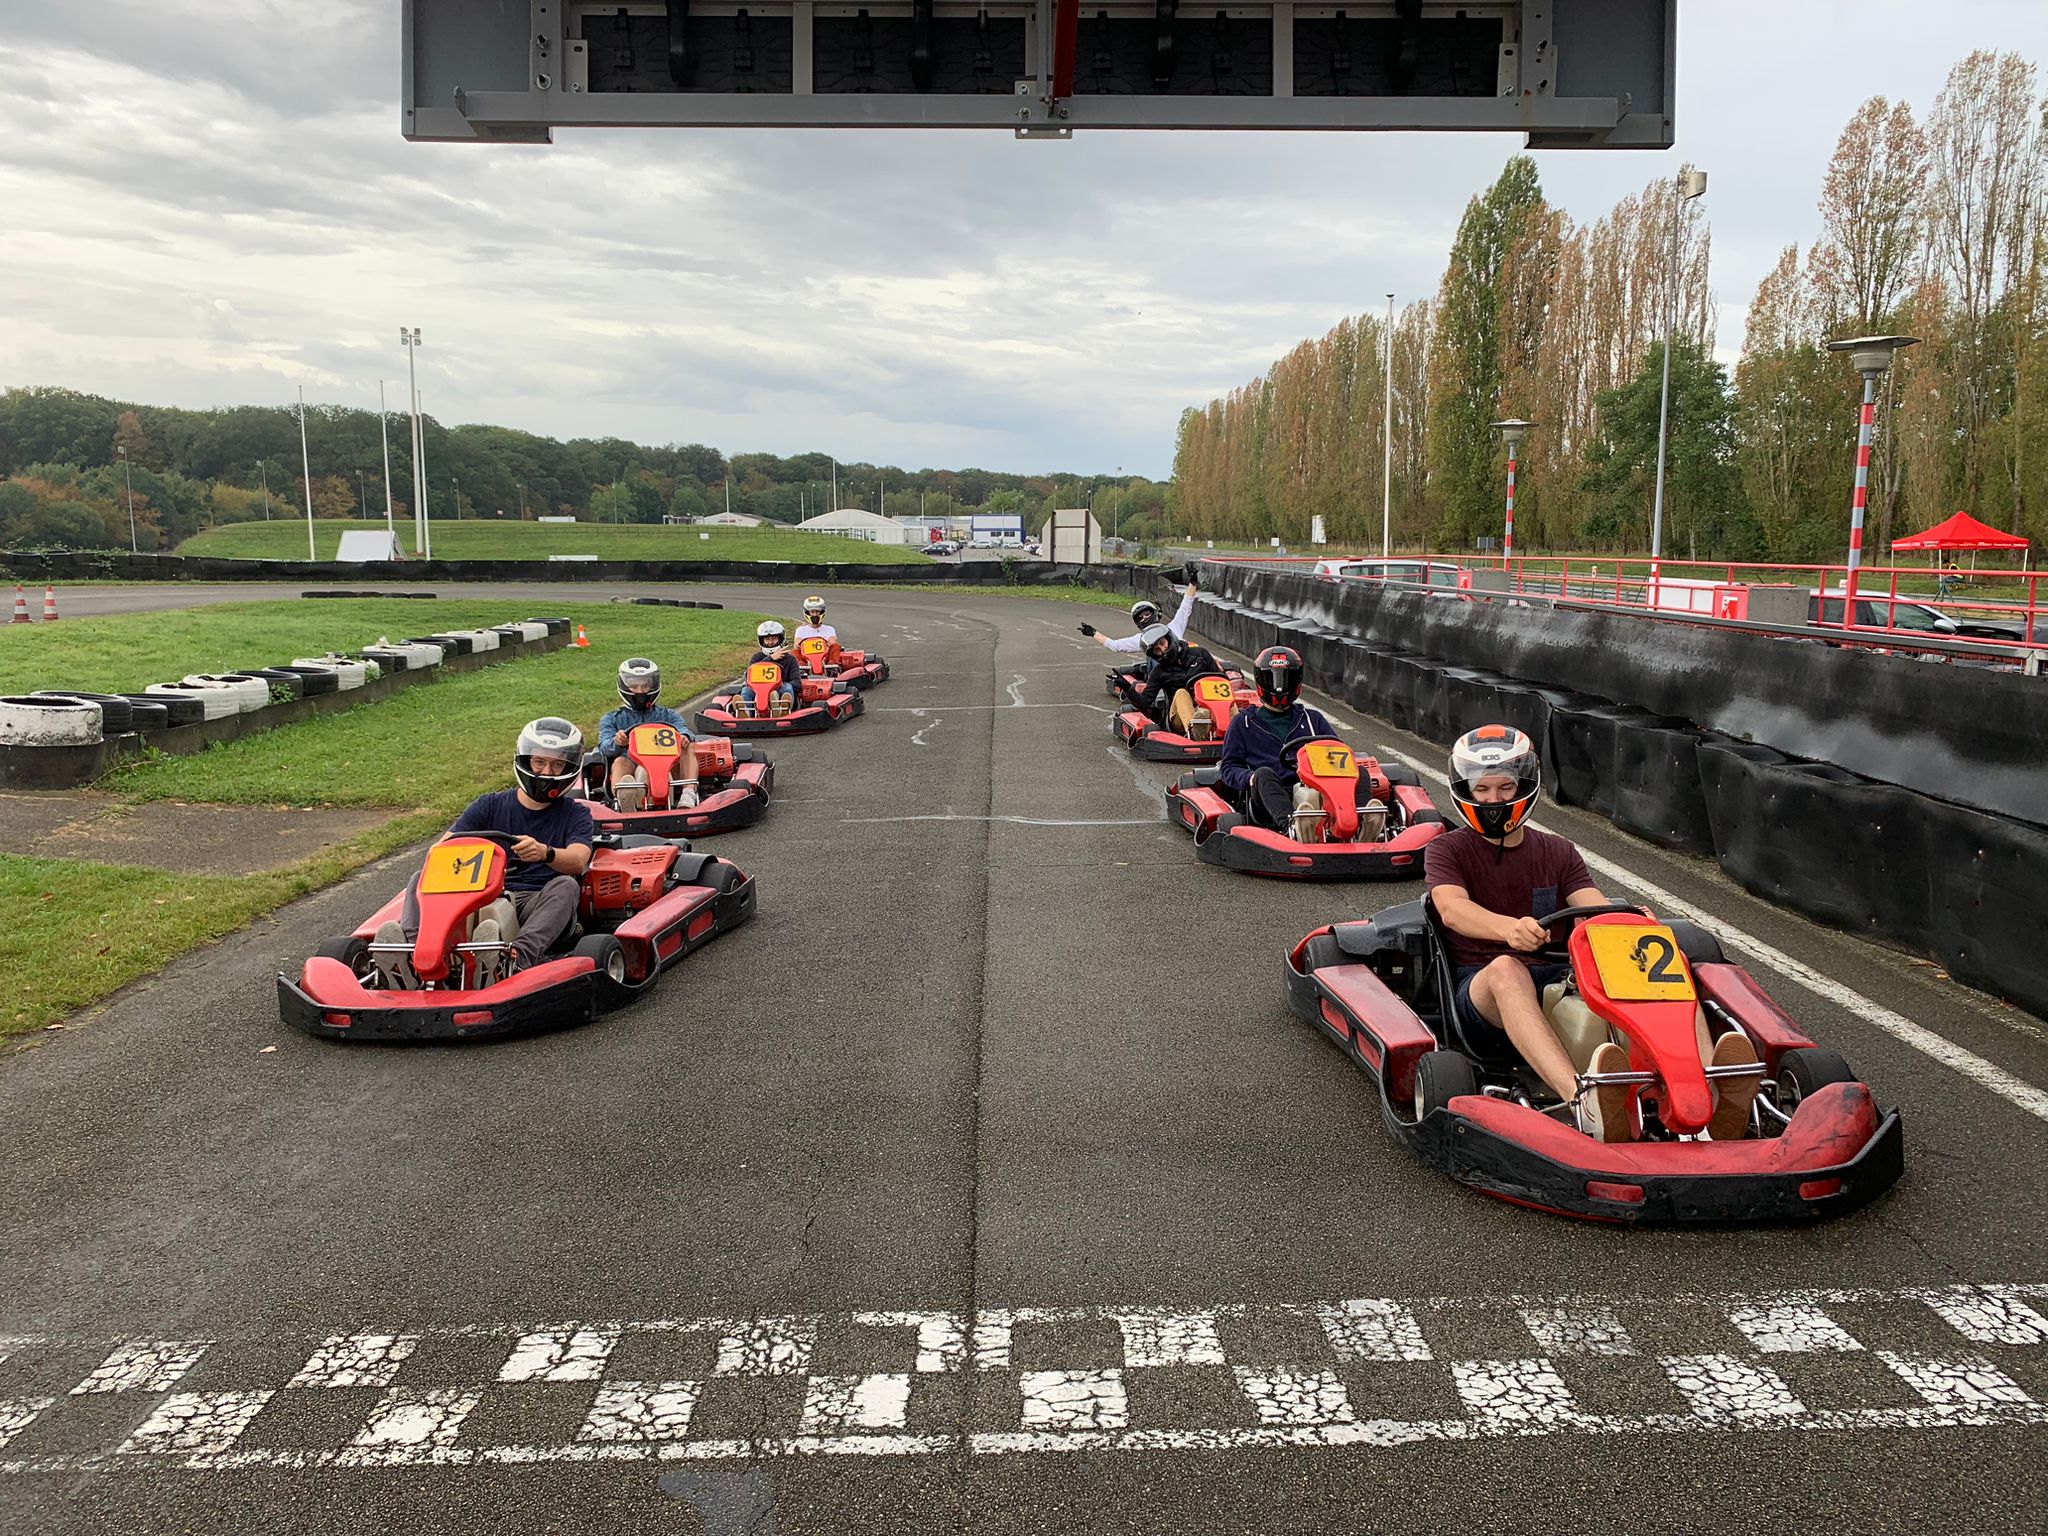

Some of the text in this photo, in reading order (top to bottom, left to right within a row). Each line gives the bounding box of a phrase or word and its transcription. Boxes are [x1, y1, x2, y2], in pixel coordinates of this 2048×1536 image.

[815, 640, 823, 651] 6
[765, 667, 775, 680] 5
[1219, 683, 1231, 698] 3
[657, 729, 676, 747] 8
[1330, 751, 1349, 769] 7
[464, 850, 484, 884] 1
[1635, 934, 1686, 983] 2
